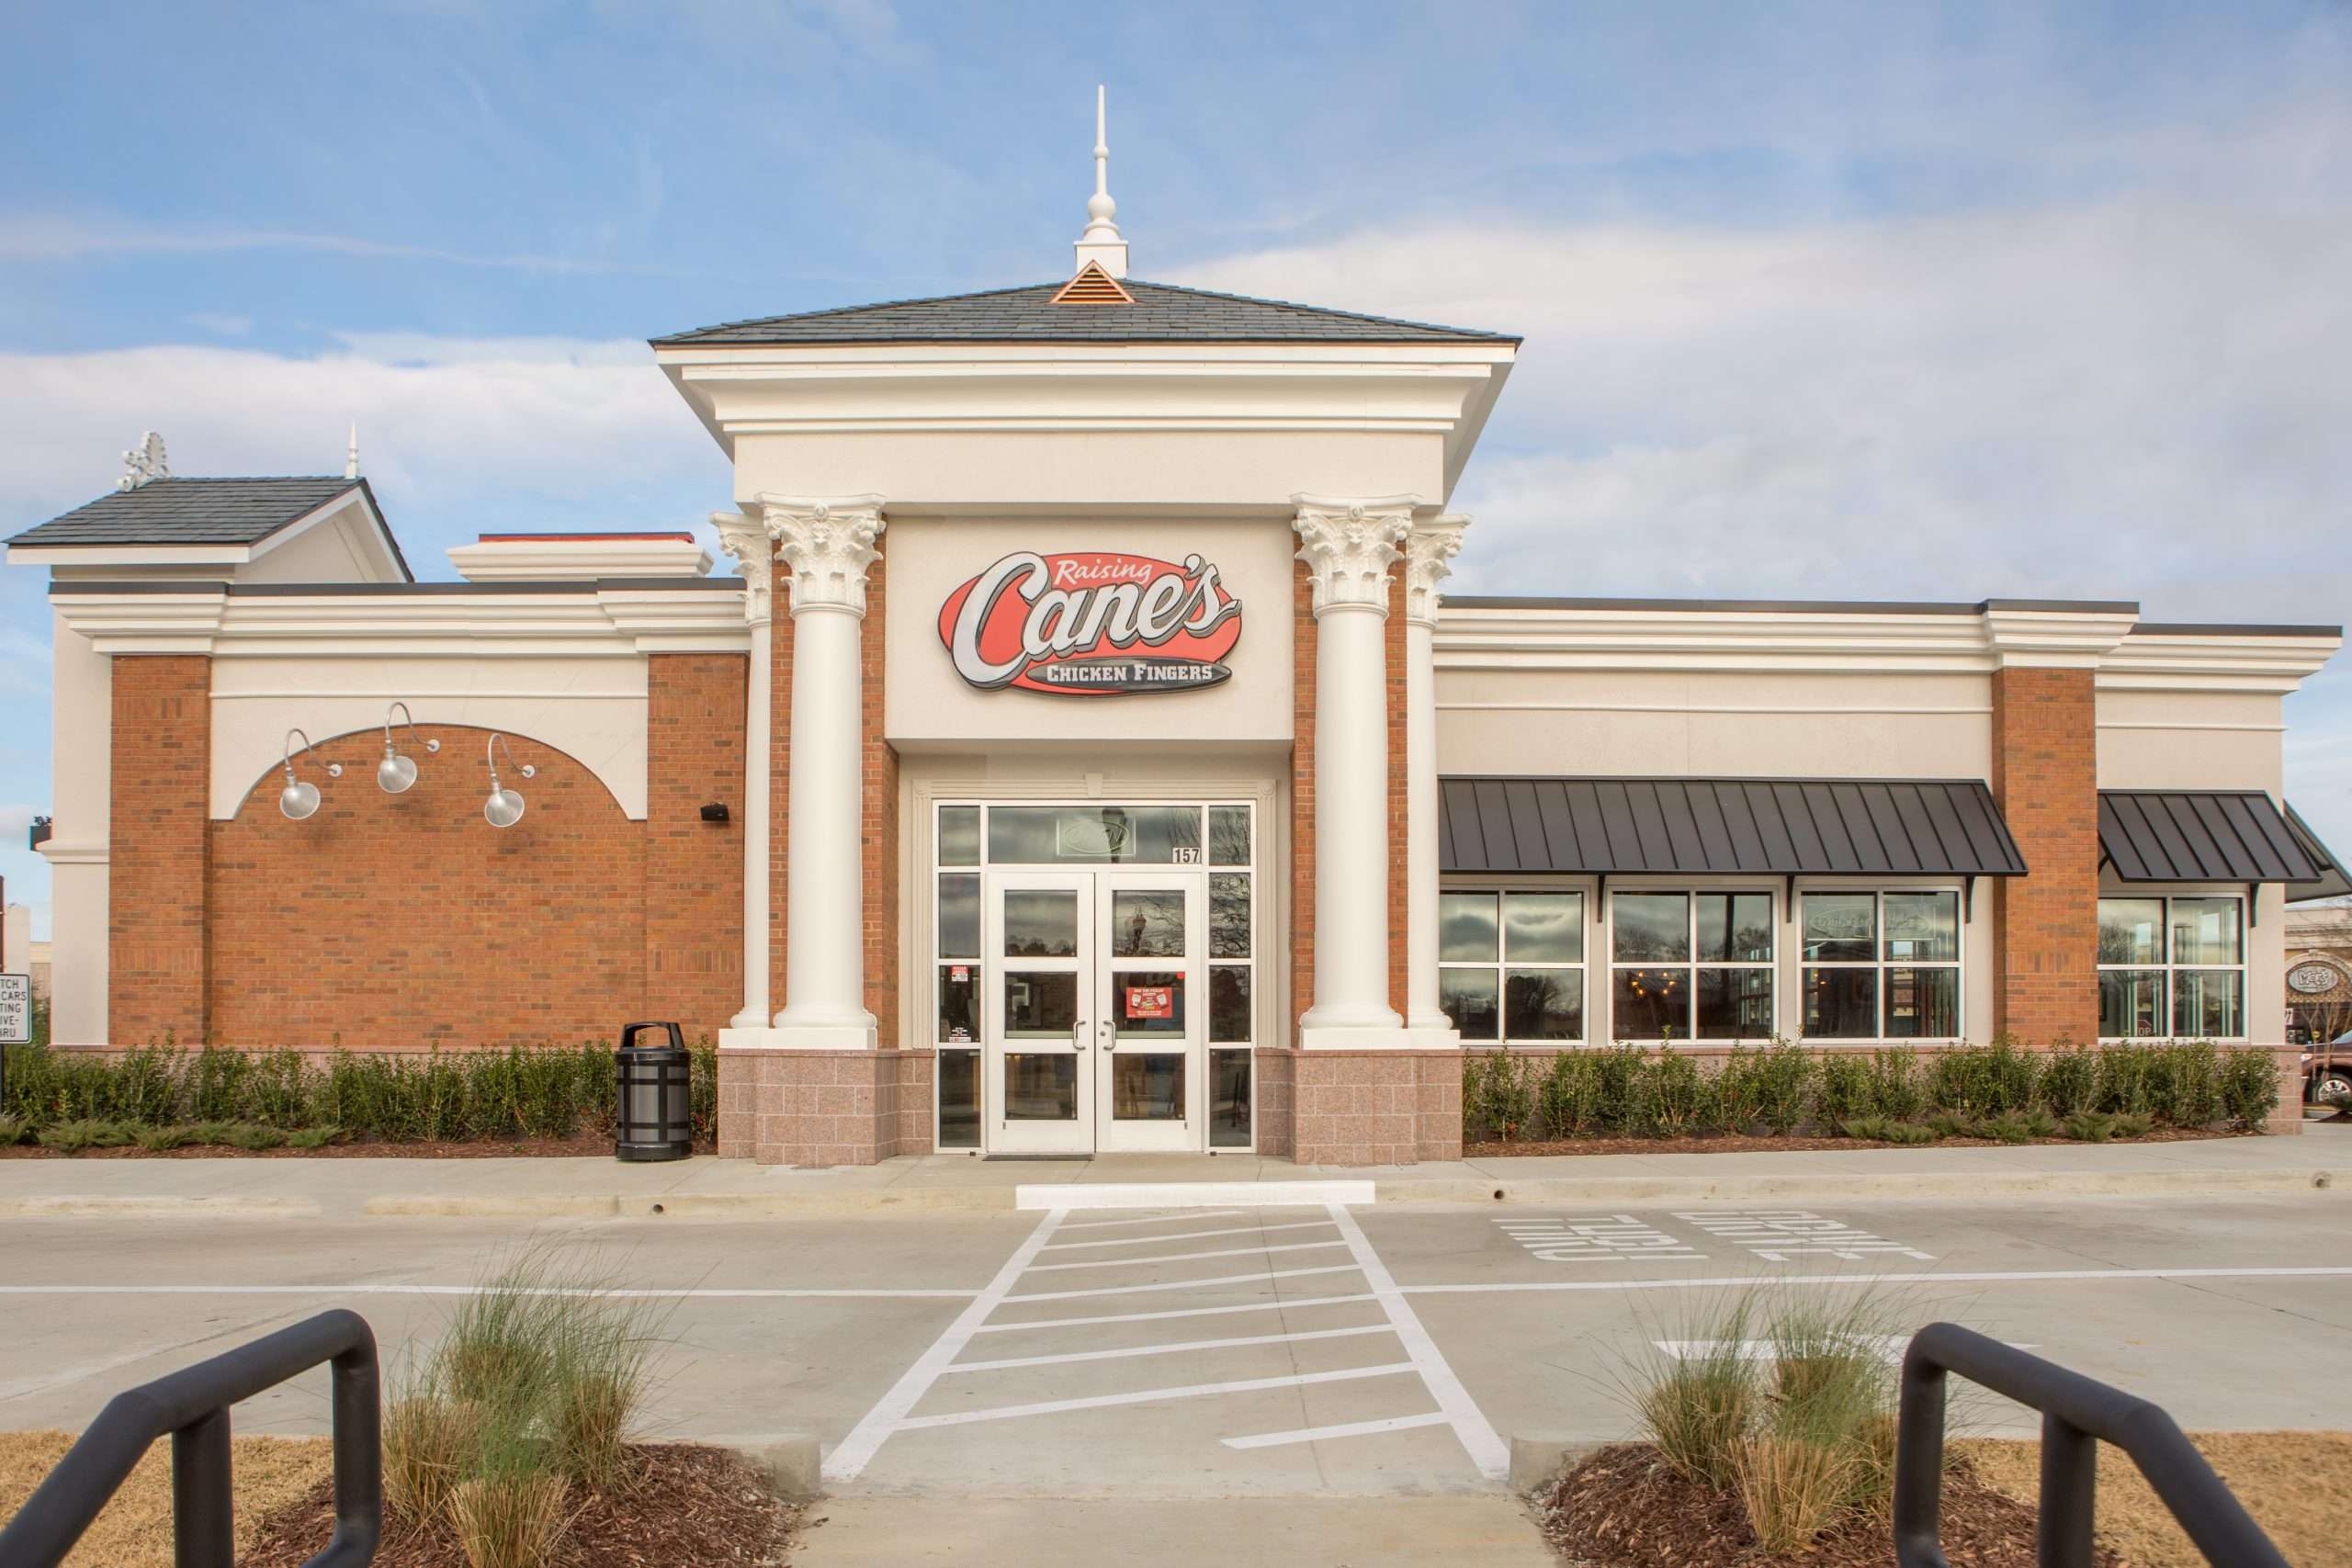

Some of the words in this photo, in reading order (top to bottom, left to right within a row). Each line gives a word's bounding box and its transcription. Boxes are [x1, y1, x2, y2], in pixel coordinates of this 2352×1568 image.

[1054, 558, 1153, 585] Raising
[952, 551, 1242, 689] Cane's
[1046, 664, 1127, 682] CHICKEN
[1133, 662, 1213, 682] FINGERS
[1175, 848, 1199, 863] 157
[1, 991, 27, 1001] CARS
[0, 1028, 16, 1038] RU
